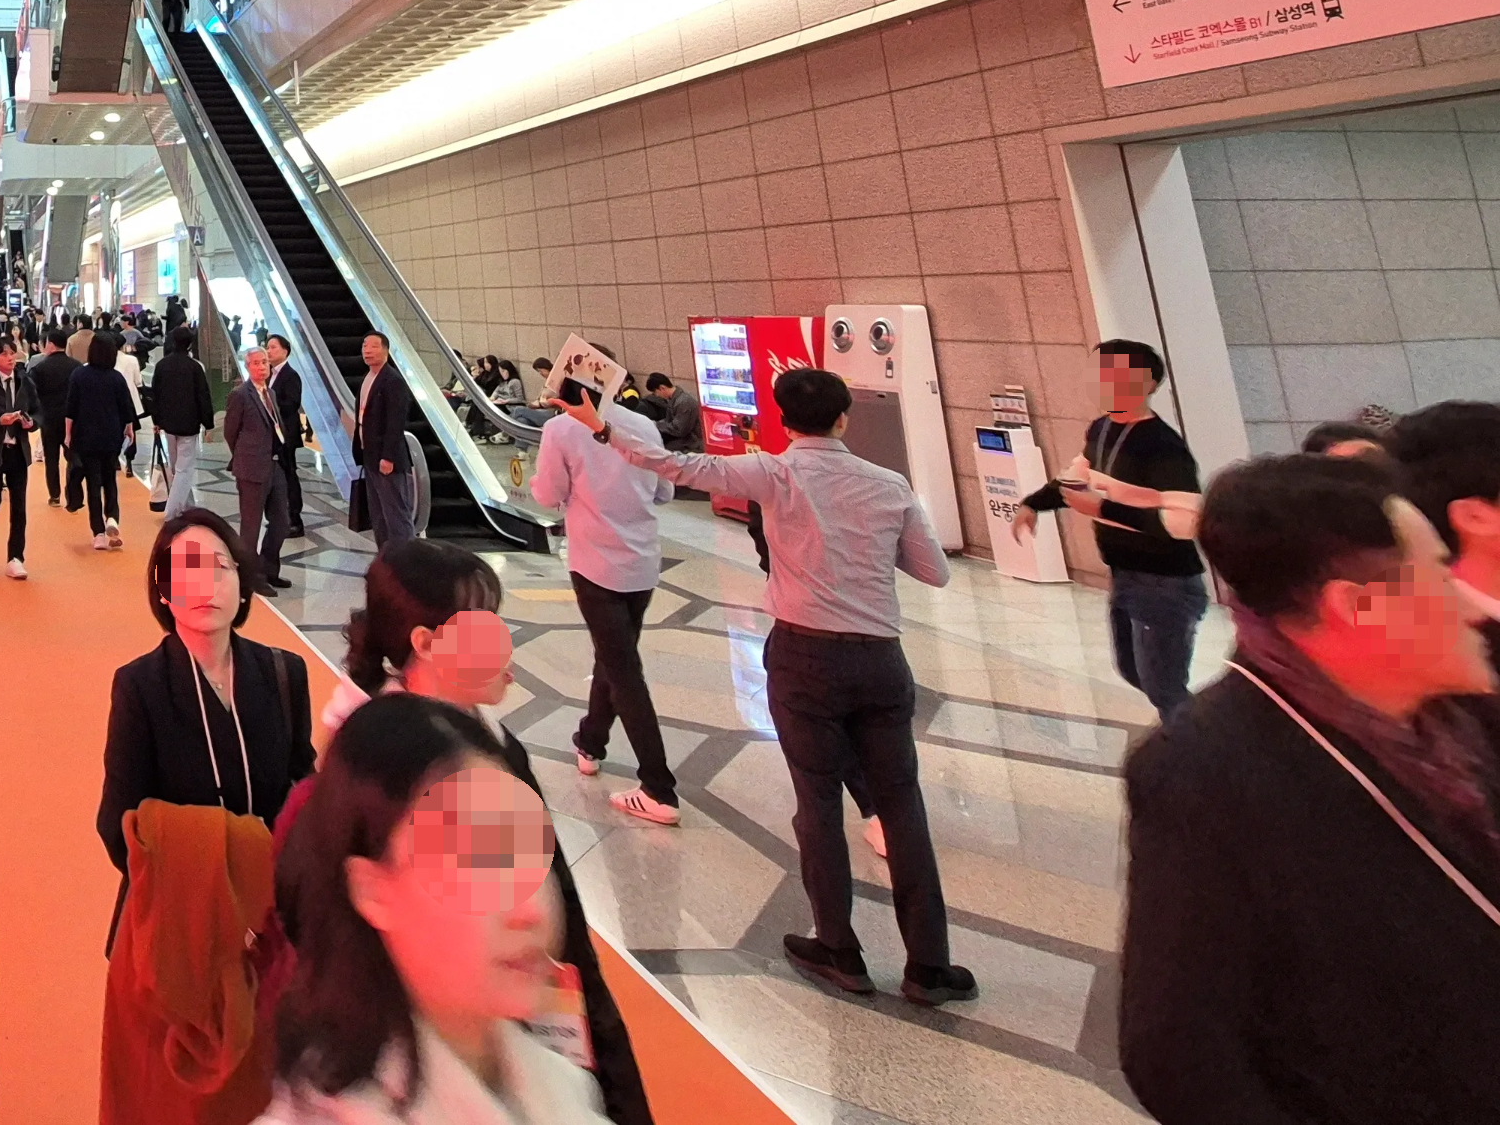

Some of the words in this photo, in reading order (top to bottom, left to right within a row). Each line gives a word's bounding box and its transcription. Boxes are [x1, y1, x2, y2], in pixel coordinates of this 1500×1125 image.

[1142, 1, 1156, 9] East
[1151, 28, 1197, 49] 스타필드
[1198, 17, 1247, 39] 코엑스몰
[1249, 17, 1262, 29] B1
[1274, 1, 1316, 23] 삼성역
